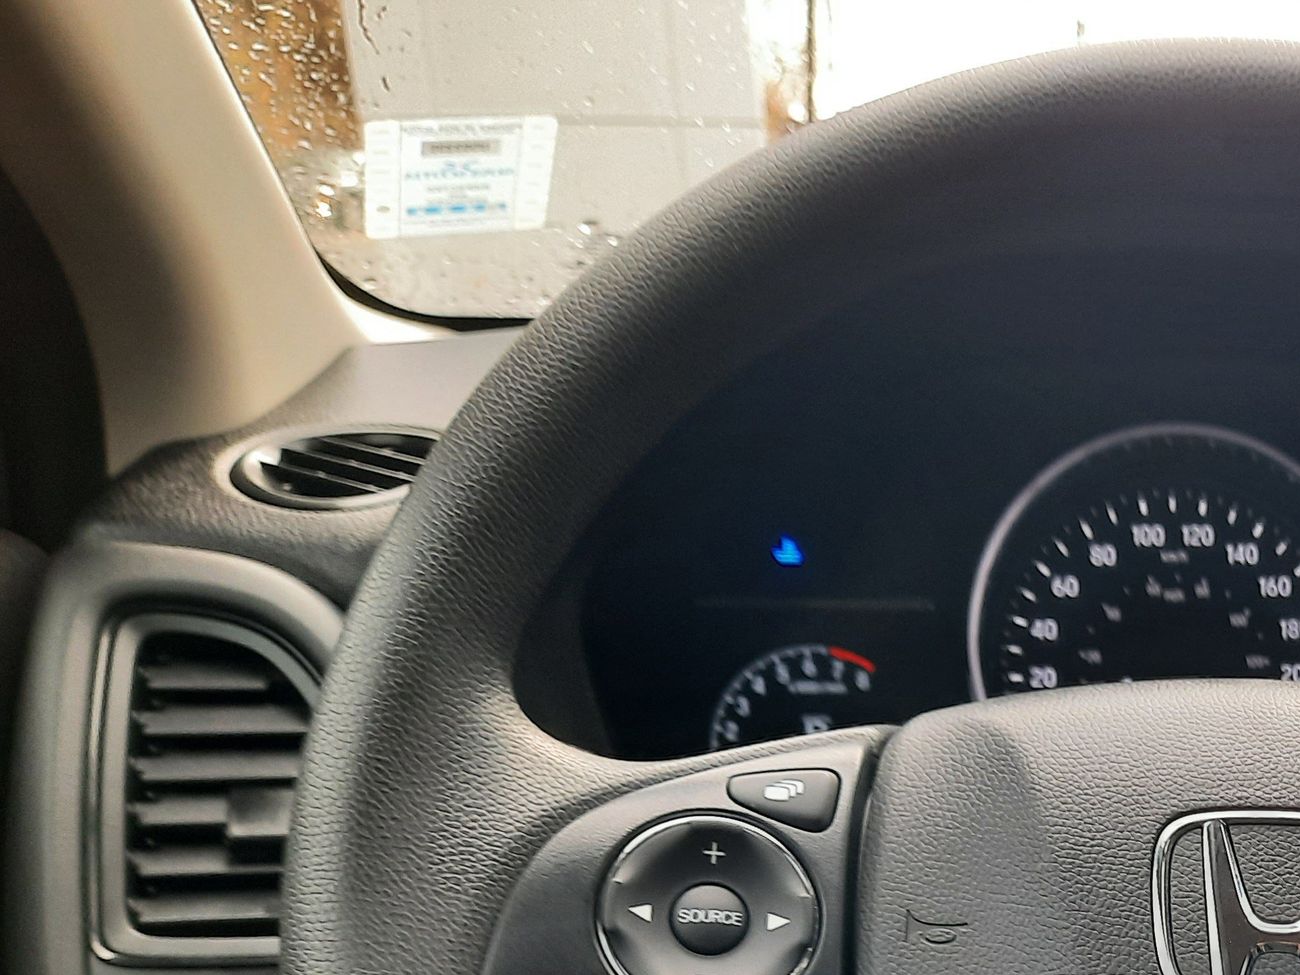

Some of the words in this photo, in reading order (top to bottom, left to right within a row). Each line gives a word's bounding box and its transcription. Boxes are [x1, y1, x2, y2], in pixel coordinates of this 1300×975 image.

[1131, 523, 1166, 548] 100
[1181, 523, 1215, 547] 120
[1089, 544, 1117, 567] 80
[1226, 542, 1259, 566] 140
[1051, 575, 1080, 598] 60
[1258, 575, 1292, 598] 160
[1030, 618, 1058, 641] 40
[1029, 666, 1057, 688] 20
[677, 909, 743, 926] SOURCE
